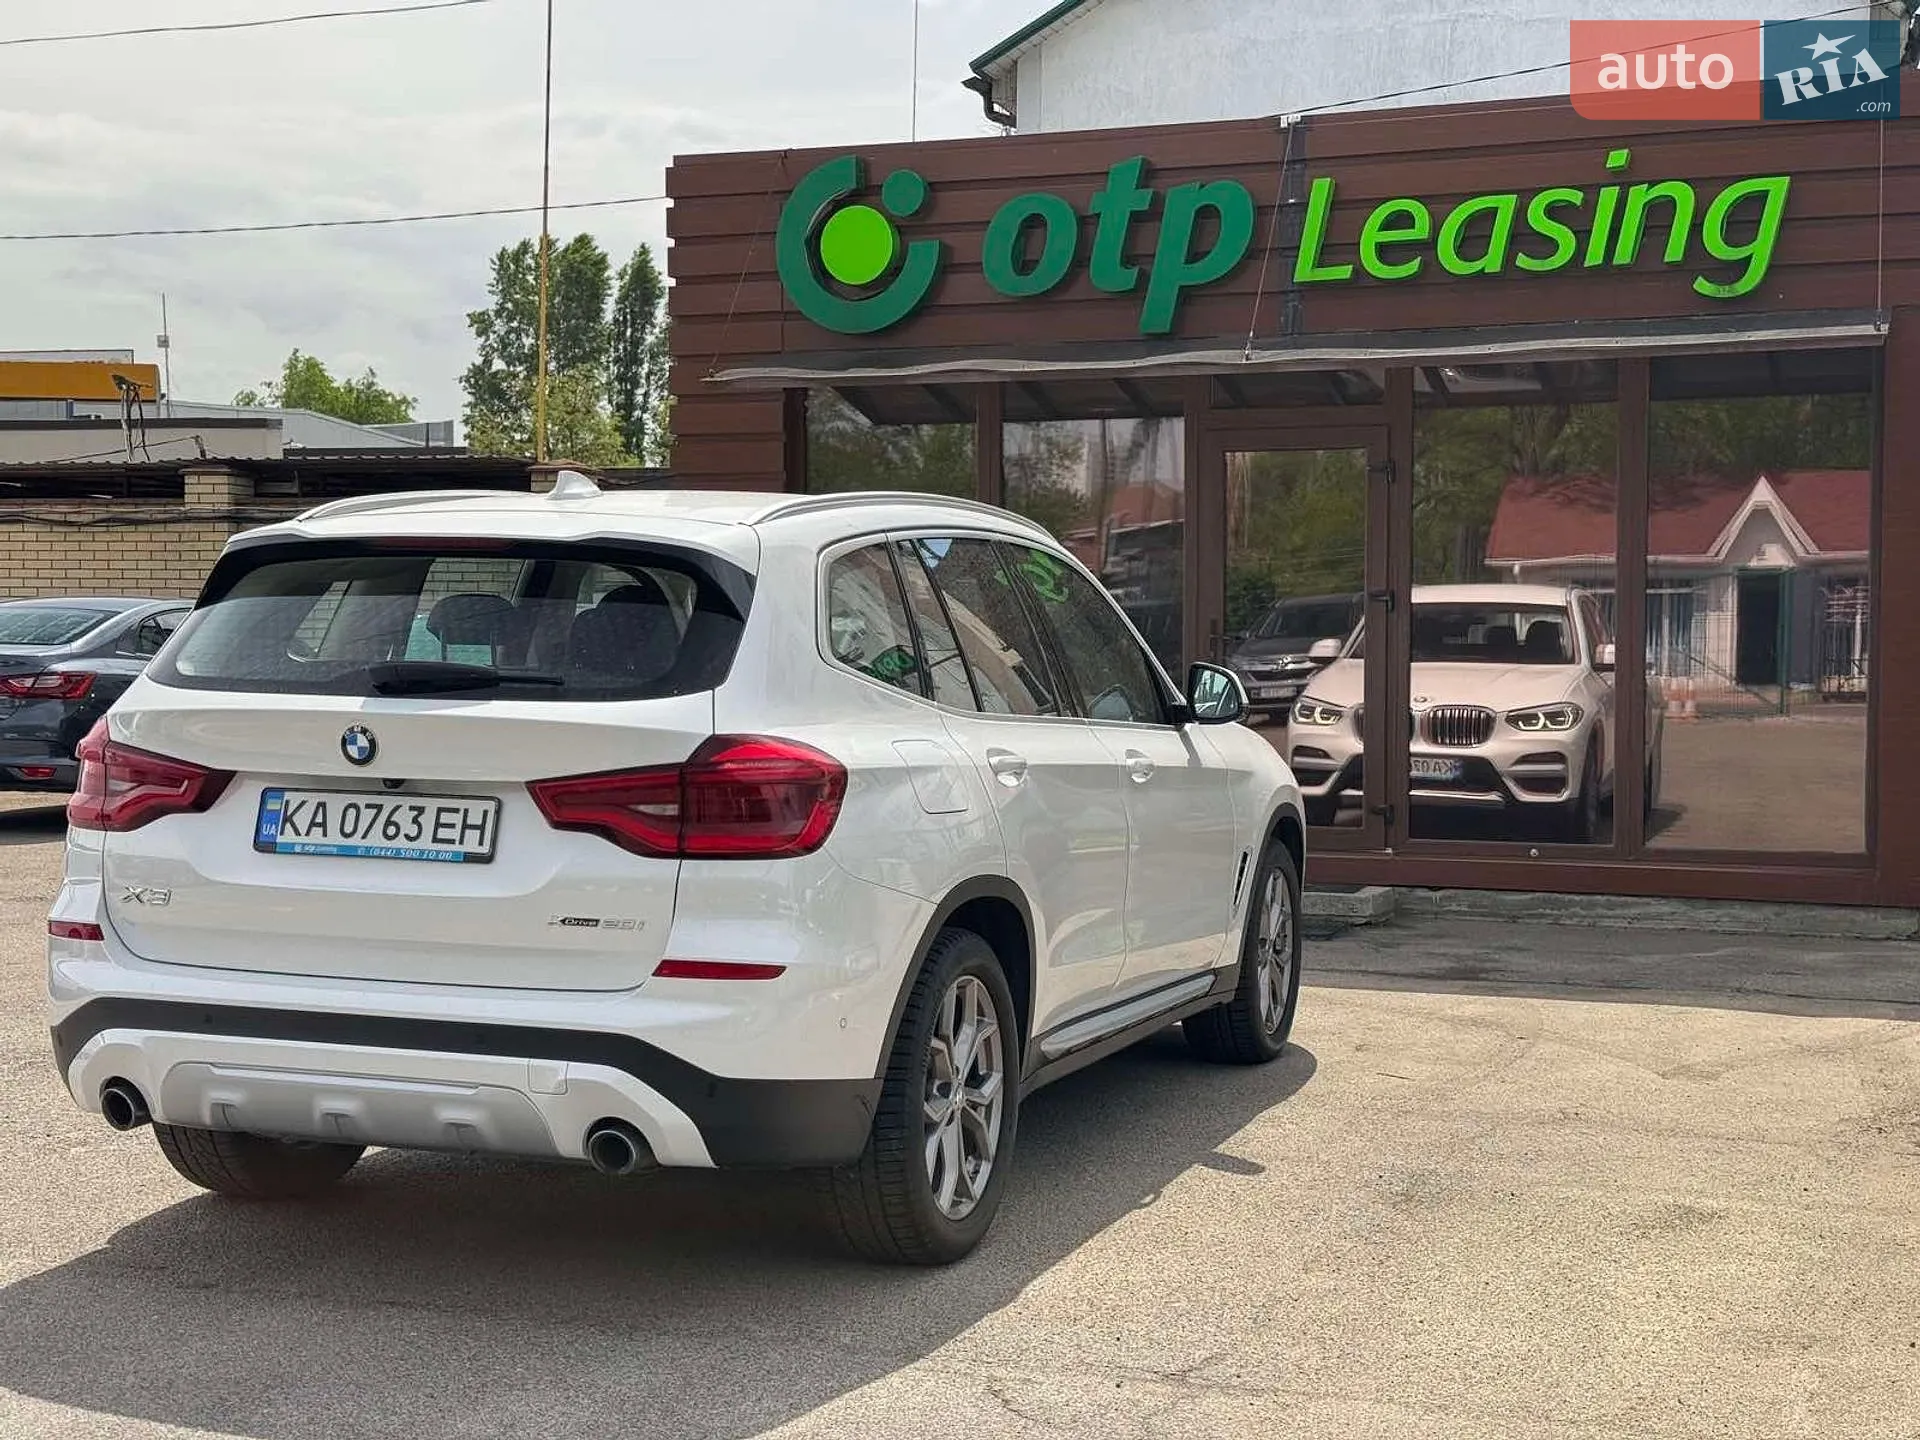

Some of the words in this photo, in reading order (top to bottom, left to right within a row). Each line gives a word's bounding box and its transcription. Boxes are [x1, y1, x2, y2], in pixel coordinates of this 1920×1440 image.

[982, 155, 1257, 335] otp
[1294, 148, 1791, 298] Leasing
[262, 824, 278, 836] UA
[280, 799, 328, 838] KA
[339, 802, 425, 842] 0763
[431, 806, 489, 846] EH
[120, 886, 173, 905] X3
